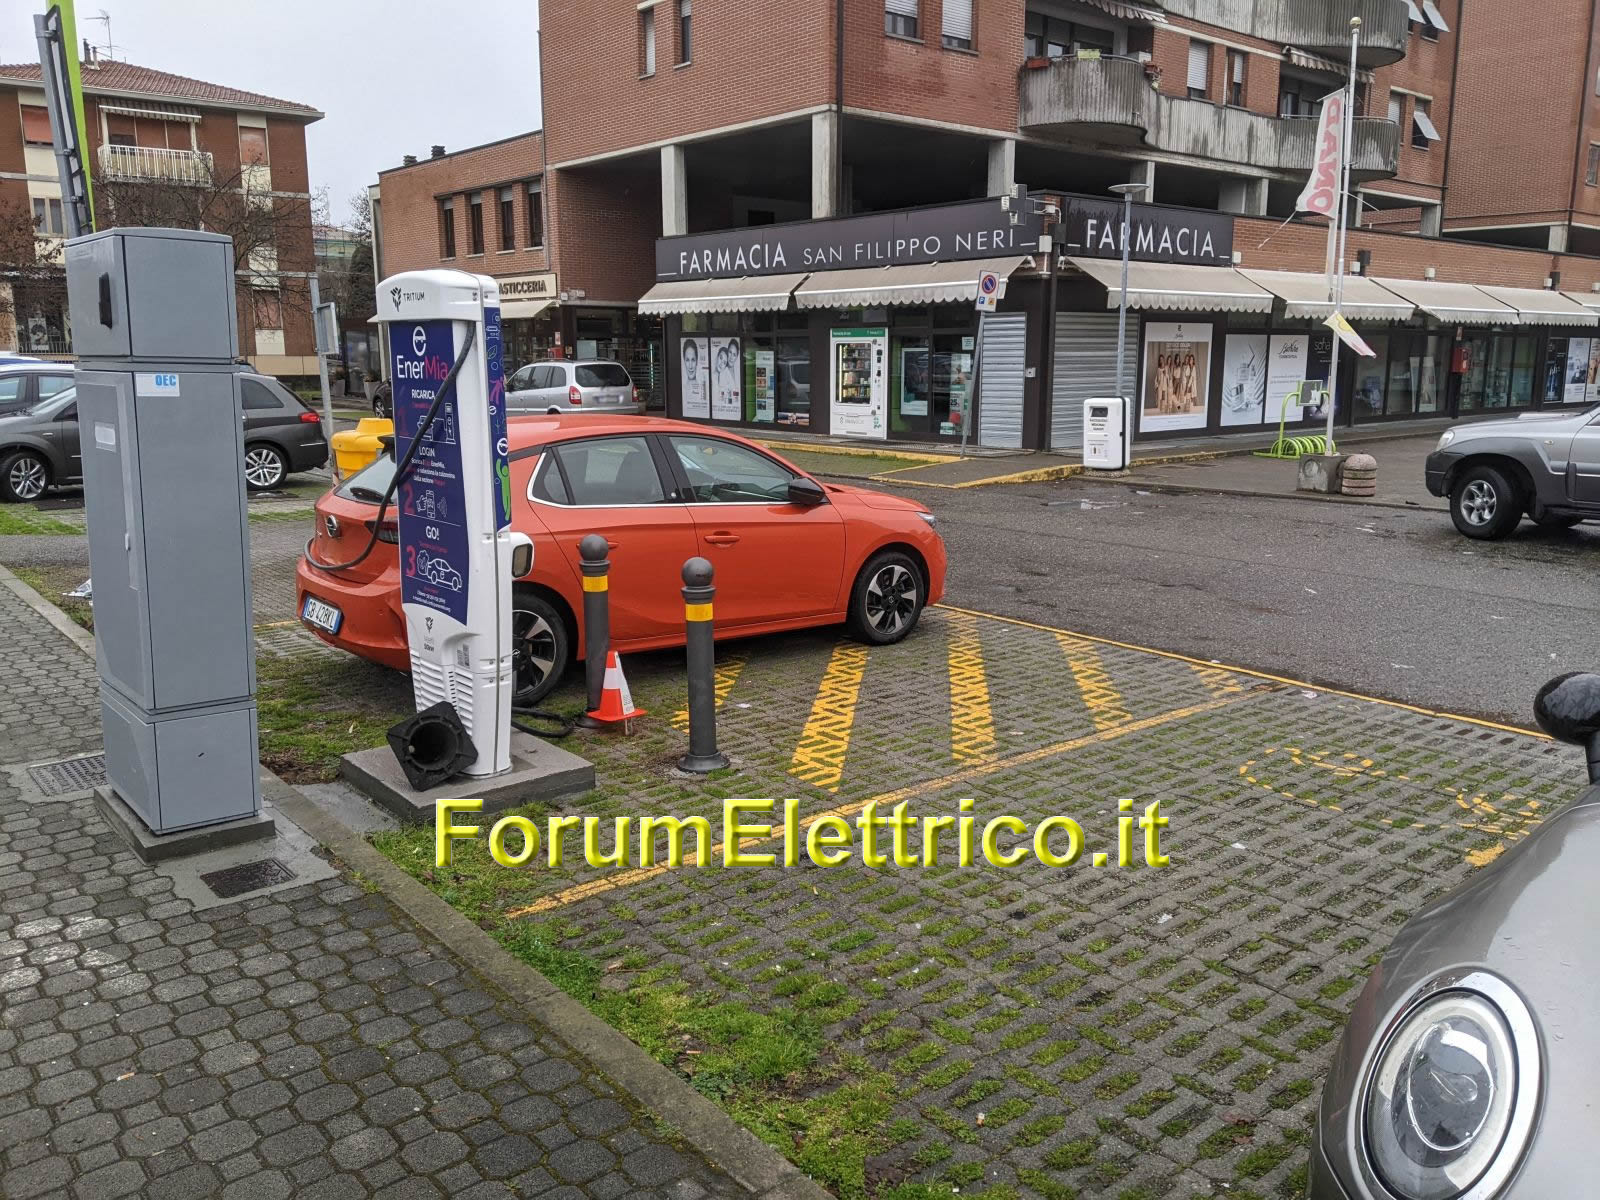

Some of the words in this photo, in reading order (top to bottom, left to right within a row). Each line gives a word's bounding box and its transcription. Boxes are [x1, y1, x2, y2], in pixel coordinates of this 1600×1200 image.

[1086, 219, 1215, 258] FARMACIA
[680, 242, 787, 275] FARMACIA
[803, 245, 842, 265] SAN
[855, 236, 941, 262] FILIPPO
[956, 228, 1014, 252] NERI
[403, 291, 425, 302] TRITIUM
[397, 355, 448, 381] EnerMia
[411, 389, 435, 400] RICARICA
[419, 446, 436, 457] LOGIN
[425, 526, 440, 540] GO!
[406, 545, 416, 576] 3
